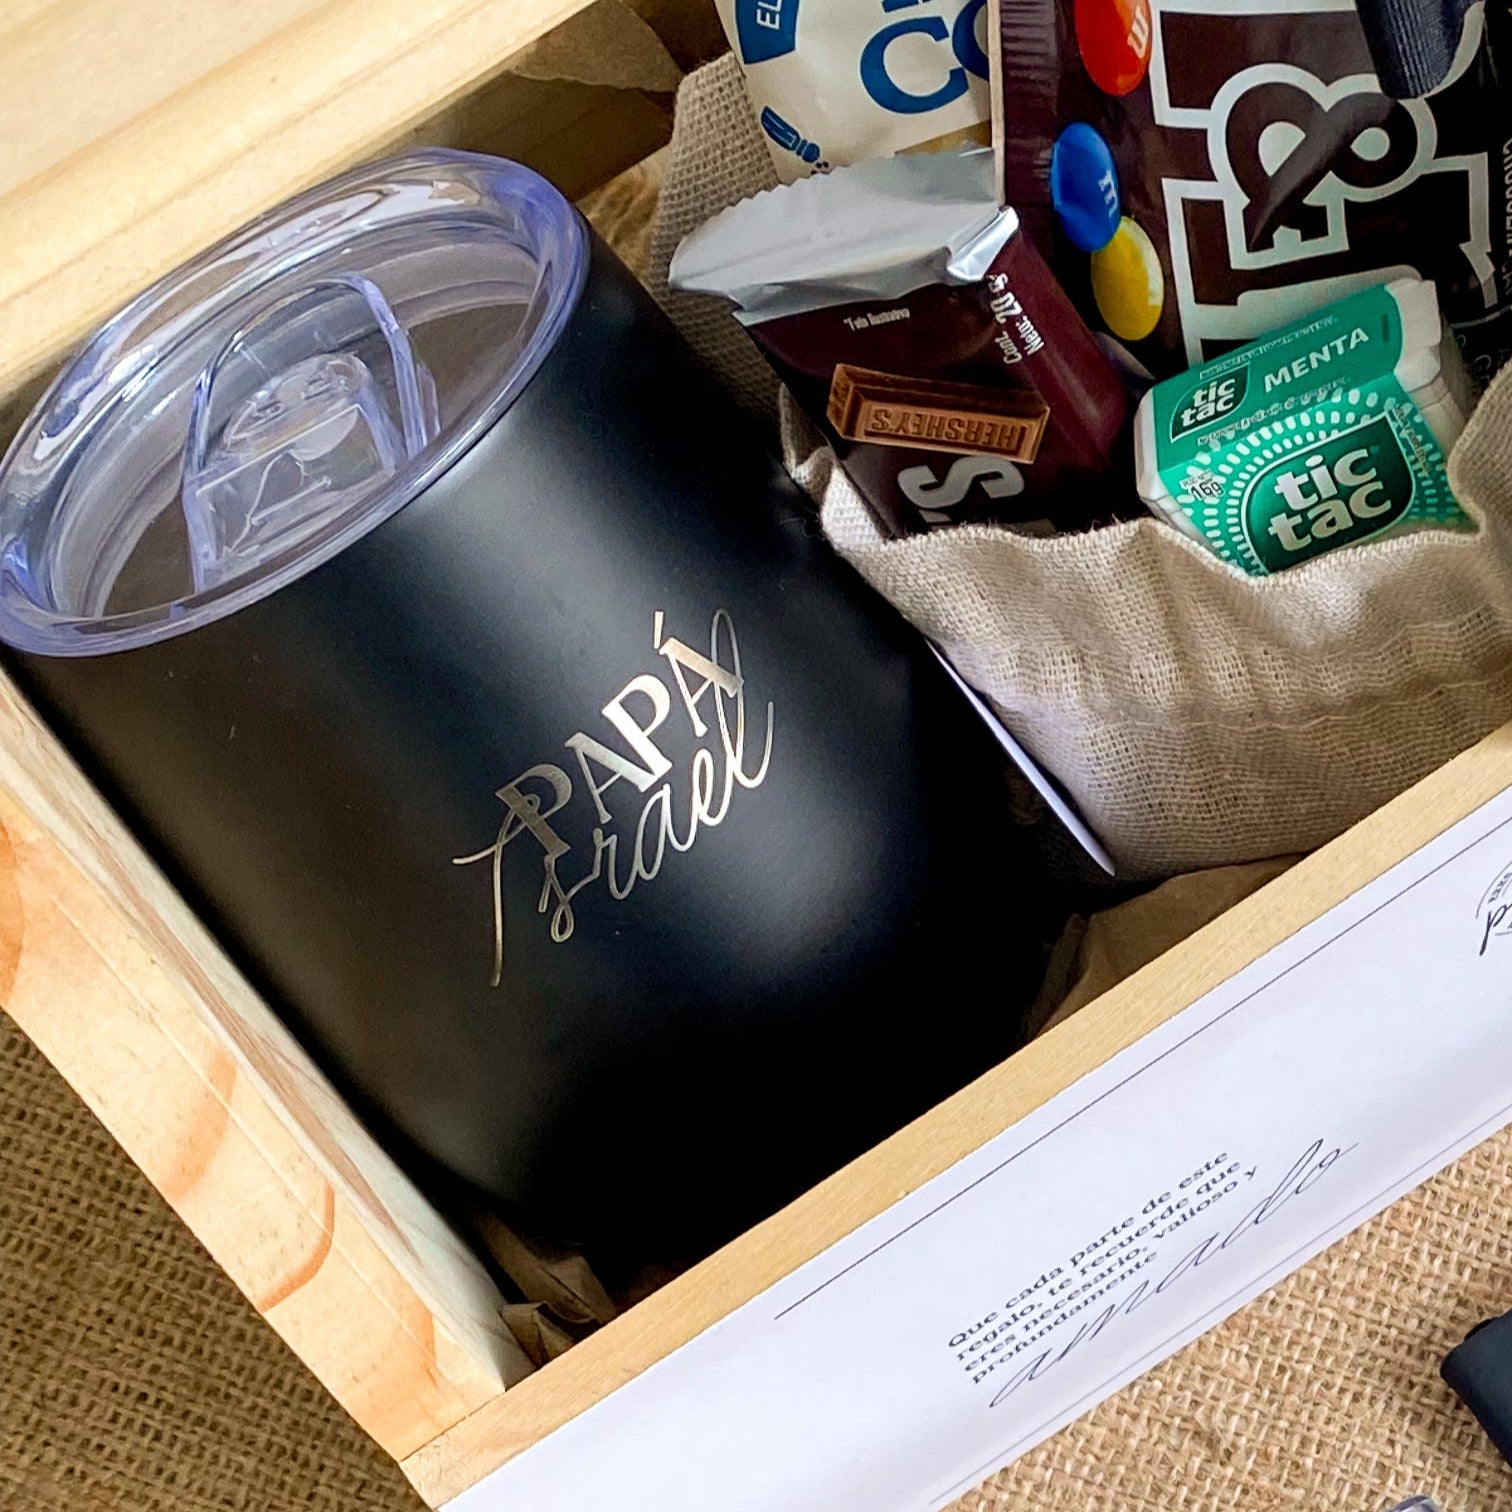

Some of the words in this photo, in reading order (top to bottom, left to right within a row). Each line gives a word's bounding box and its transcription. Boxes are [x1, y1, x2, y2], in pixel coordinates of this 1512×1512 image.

[1193, 377, 1236, 408] tic
[1264, 327, 1370, 393] MENTA
[1181, 395, 1235, 427] tac
[1268, 481, 1391, 551] tac
[1274, 447, 1377, 511] tic
[495, 610, 744, 858] PAPÁ
[948, 1311, 998, 1348] Que
[1005, 1266, 1064, 1311] cada
[1069, 1215, 1136, 1268] parte
[1141, 1188, 1172, 1215] de
[1178, 1151, 1229, 1190] este
[957, 1302, 1043, 1361] regalo,
[1047, 1277, 1073, 1299] te
[1078, 1206, 1190, 1275] recuerde
[1195, 1161, 1241, 1198] que
[964, 1333, 1017, 1374] eres
[1023, 1245, 1149, 1333] necesario,
[1152, 1179, 1240, 1240] valioso
[1243, 1165, 1258, 1181] y
[972, 1252, 1159, 1385] profundamente
